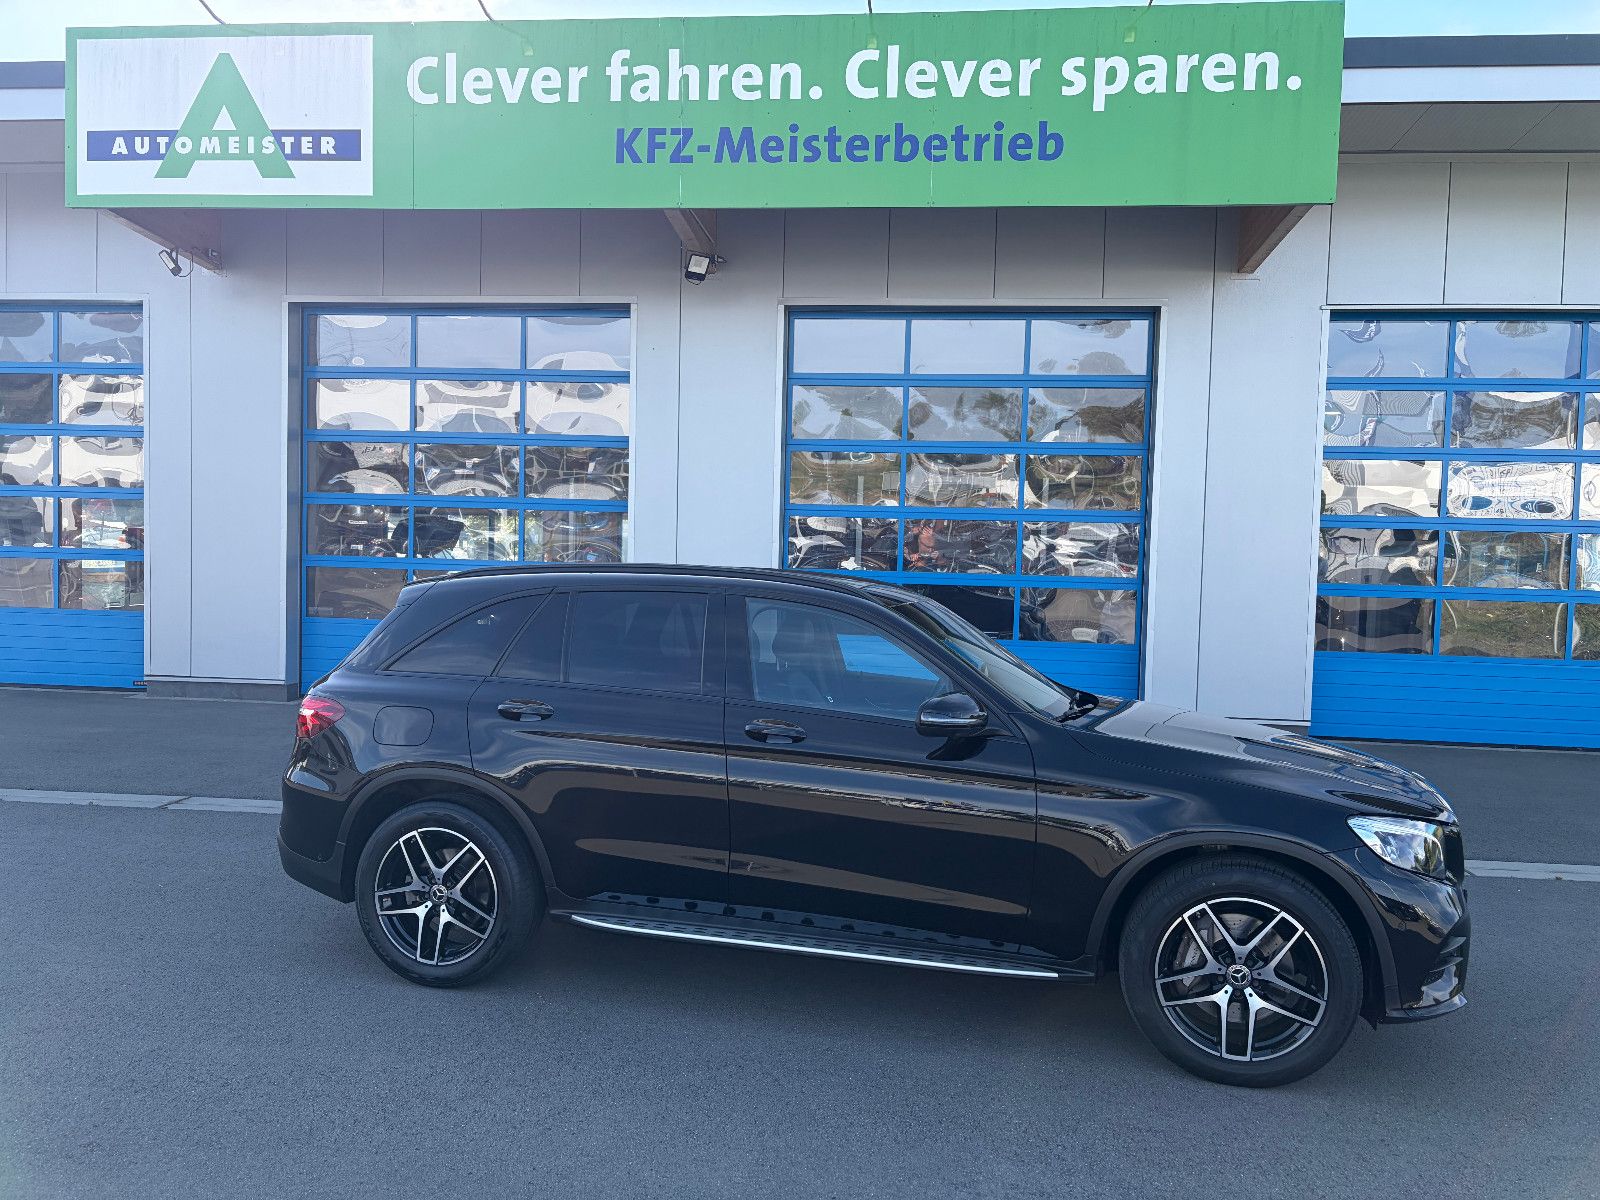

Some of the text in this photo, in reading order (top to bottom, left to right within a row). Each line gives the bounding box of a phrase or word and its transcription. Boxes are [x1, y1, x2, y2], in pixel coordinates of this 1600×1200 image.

[407, 45, 1303, 111] Clever fahren. Clever sparen.
[111, 136, 337, 155] AUTOMEISTER
[615, 121, 1065, 164] KFZ-Meisterbetrieb
